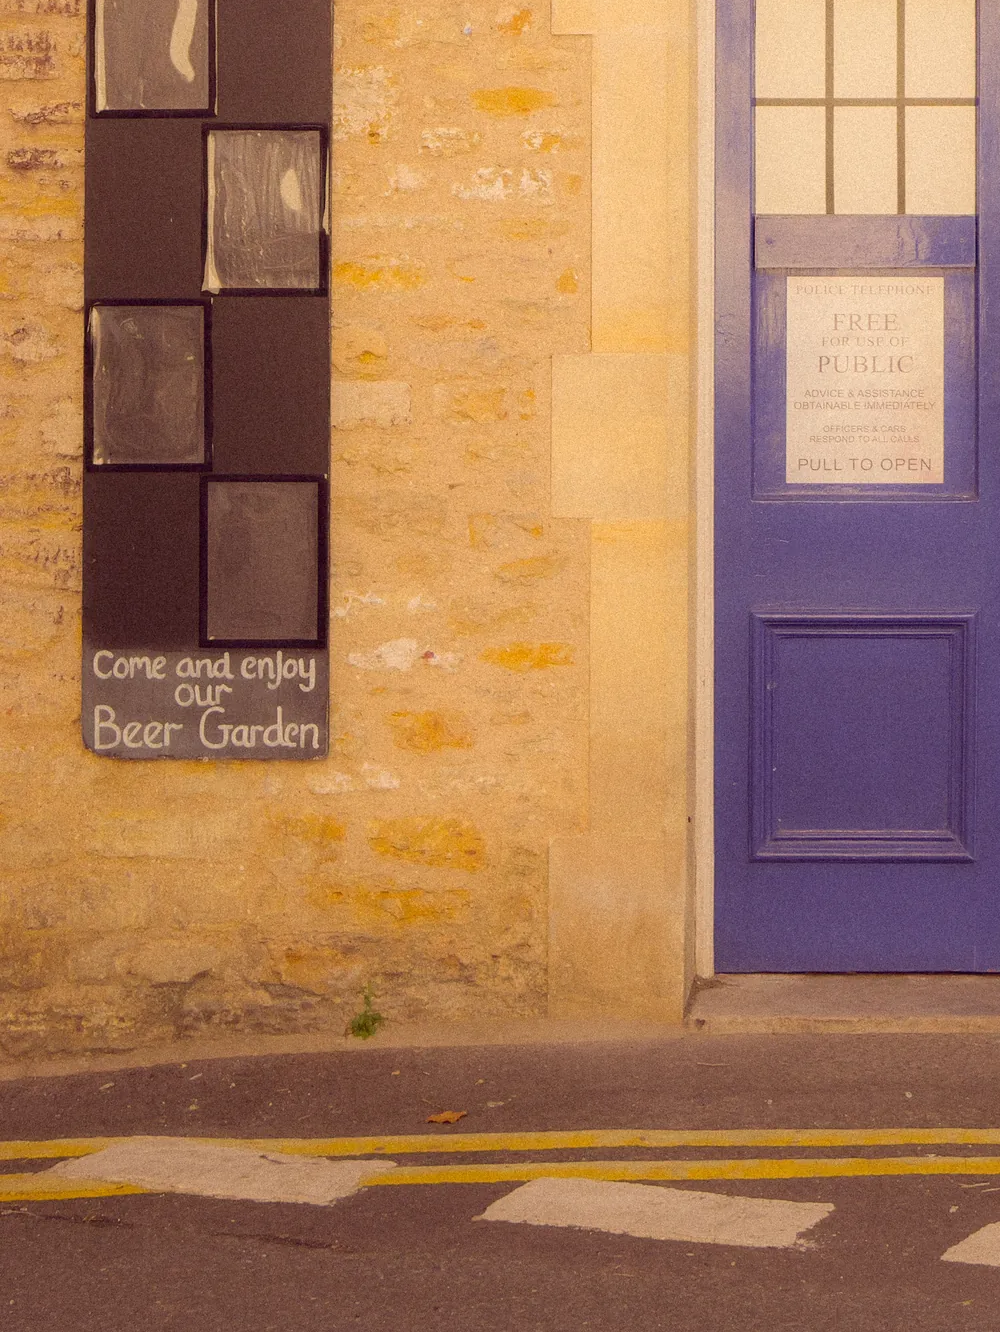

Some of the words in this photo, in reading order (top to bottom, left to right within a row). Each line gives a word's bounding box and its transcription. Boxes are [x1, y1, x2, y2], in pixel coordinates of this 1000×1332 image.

[796, 284, 849, 296] POLICE
[852, 284, 935, 296] TELEPHONE
[832, 313, 899, 331] FREE
[821, 336, 850, 347] FOR
[856, 336, 884, 347] USE
[889, 336, 909, 347] OF
[818, 355, 914, 374] PUBLIC
[804, 389, 844, 398] ADVICE
[847, 389, 855, 398] &
[857, 389, 925, 398] ASSISTANCE
[793, 401, 861, 410] OBTAINABLE
[863, 401, 936, 410] IMMEDIATELY
[823, 425, 869, 433] OFFICERS
[872, 425, 879, 433] &
[881, 425, 907, 433] CARS
[809, 435, 854, 443] RESPOND
[858, 435, 870, 443] TO
[872, 435, 888, 443] ALL
[890, 435, 920, 443] CALLS
[797, 458, 842, 471] PULL
[849, 458, 873, 471] TO
[880, 458, 932, 471] OPEN
[93, 649, 167, 680] Come
[175, 652, 234, 680] and
[240, 650, 316, 692] enjoy
[174, 683, 233, 707] our
[93, 704, 184, 750] Beer
[199, 705, 320, 750] Garden
